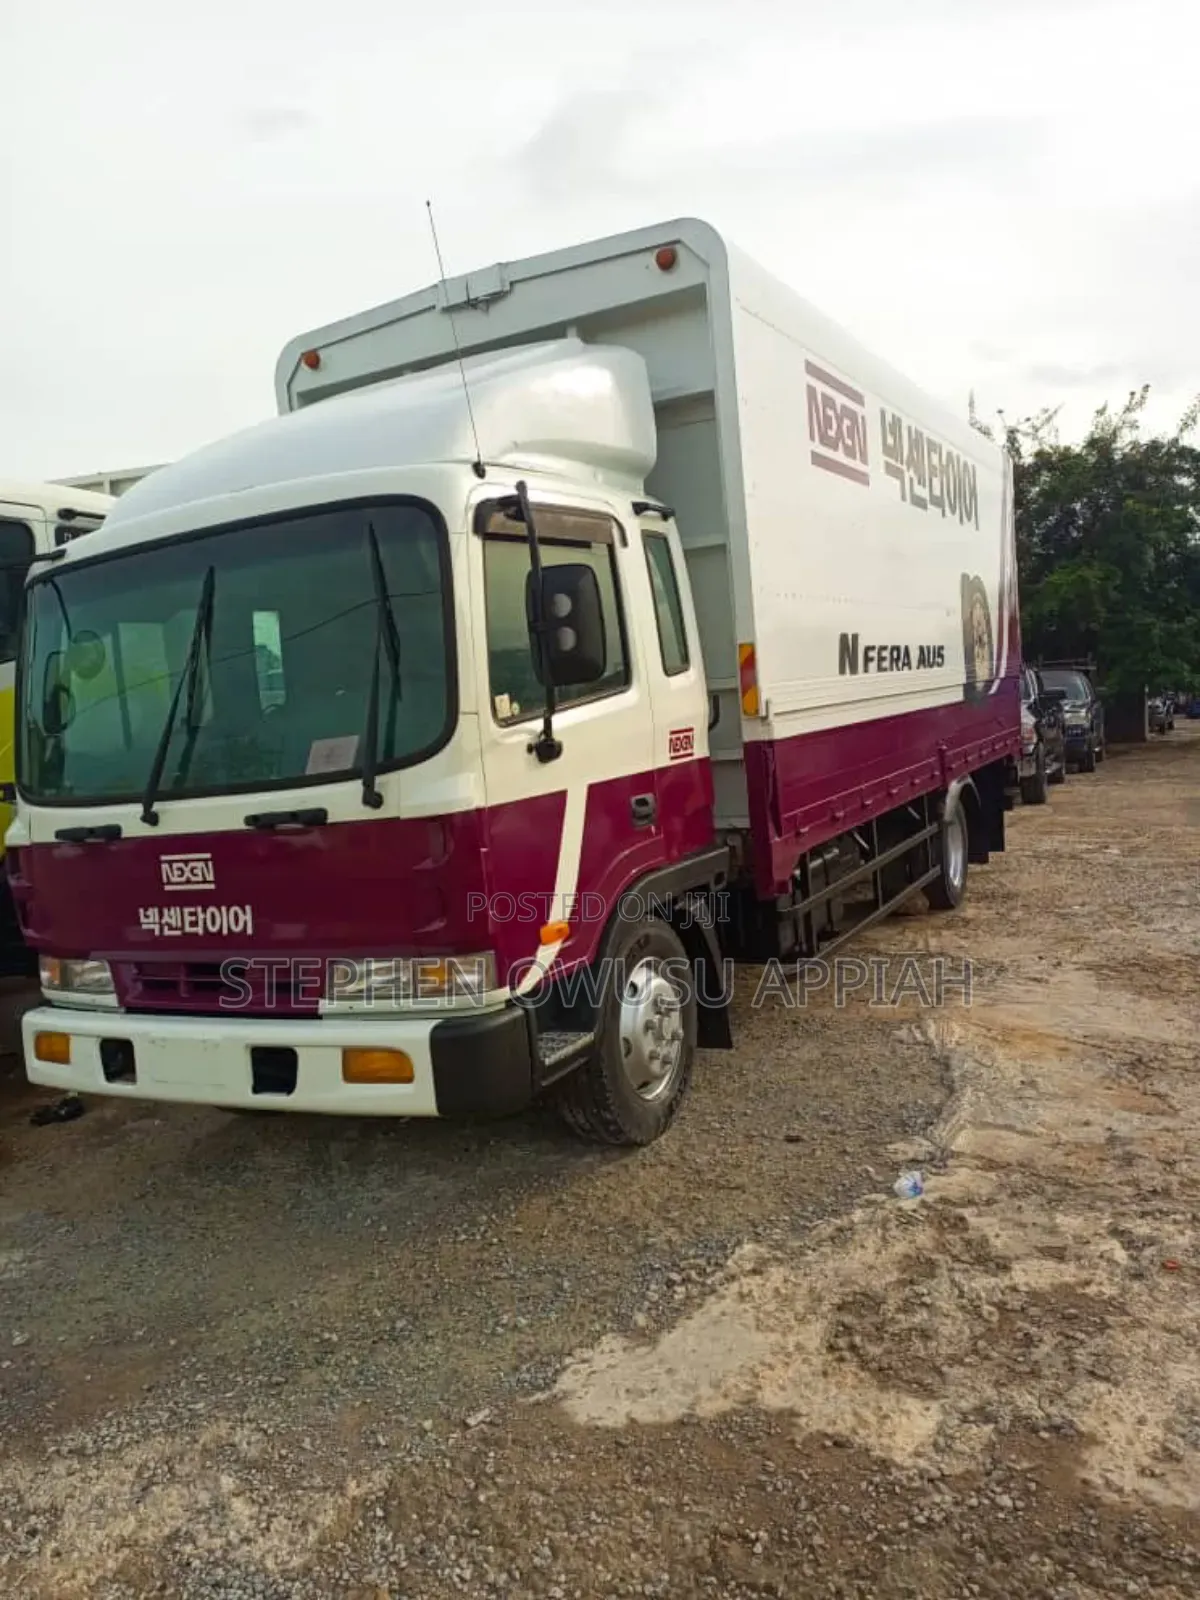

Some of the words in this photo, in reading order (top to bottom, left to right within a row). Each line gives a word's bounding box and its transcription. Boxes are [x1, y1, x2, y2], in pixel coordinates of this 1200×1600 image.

[806, 382, 869, 466] NEXEN
[879, 406, 980, 531] 넥센타이어
[839, 632, 859, 675] N
[863, 644, 912, 673] FERA
[161, 860, 215, 883] NEXEN
[139, 904, 253, 937] 넥센타이어
